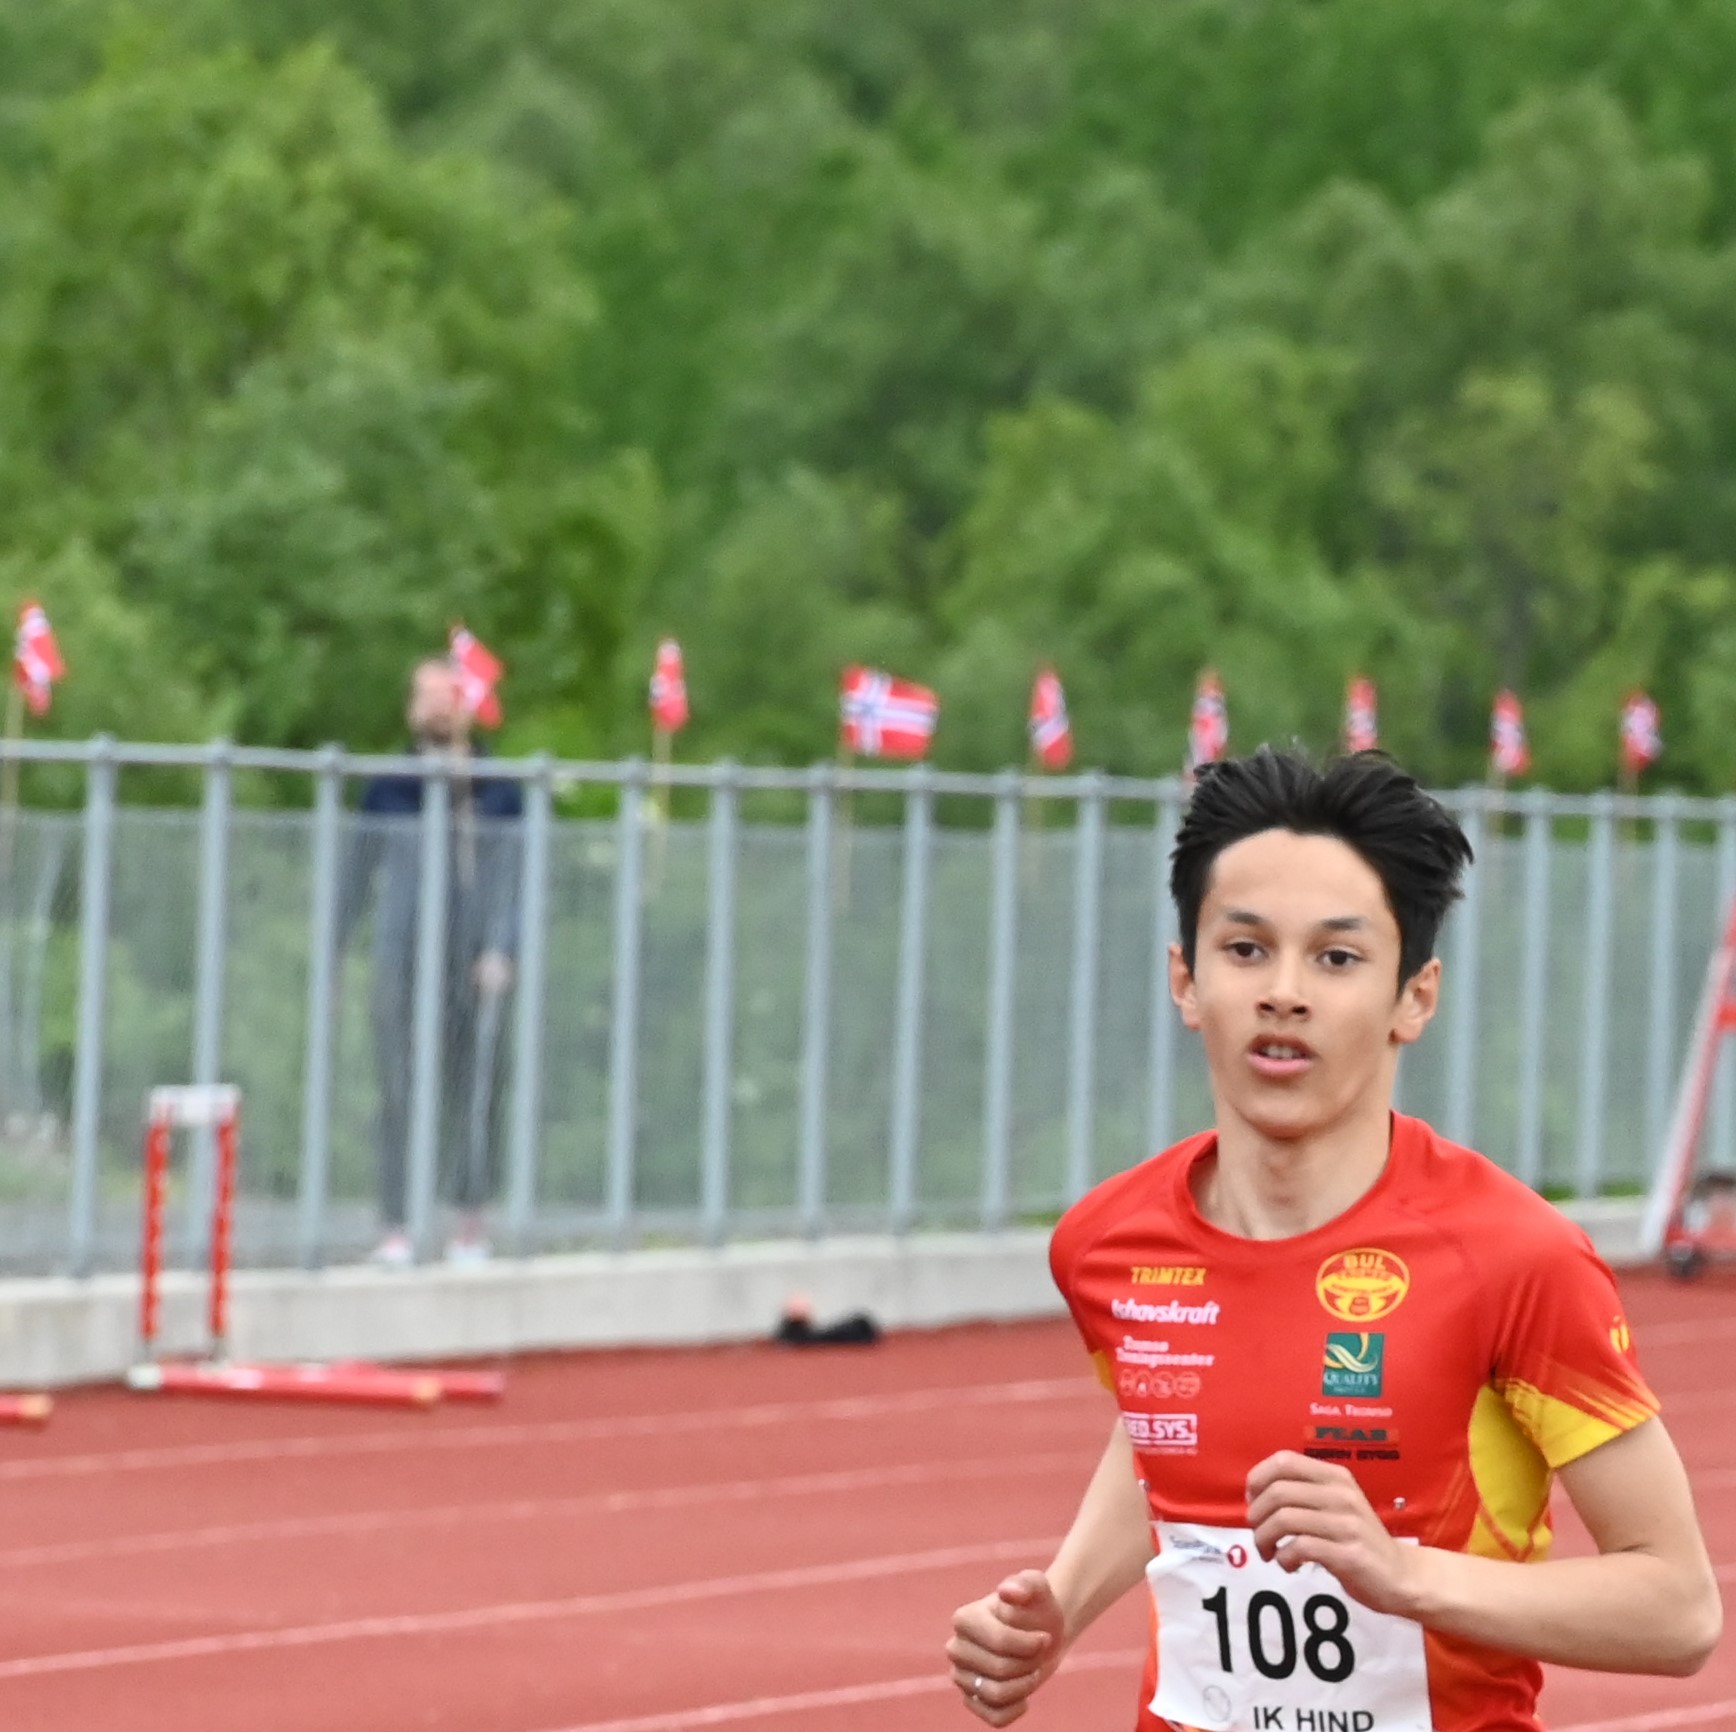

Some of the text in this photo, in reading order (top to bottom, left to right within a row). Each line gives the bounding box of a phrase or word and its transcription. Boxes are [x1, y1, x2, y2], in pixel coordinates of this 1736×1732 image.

[1131, 1266, 1207, 1285] TRIMTEX
[1202, 1585, 1356, 1683] 108
[1253, 1706, 1284, 1731] IK
